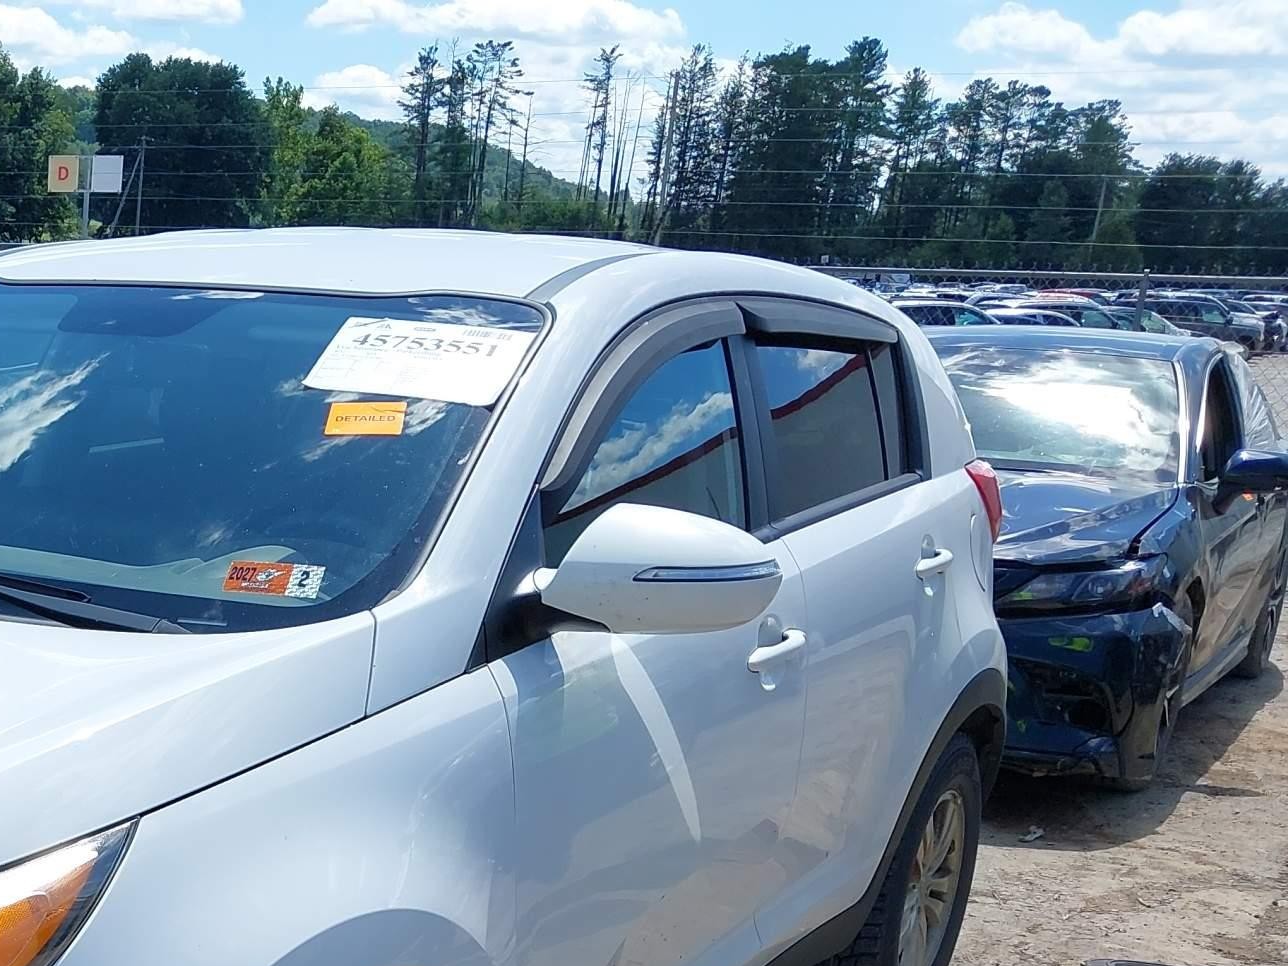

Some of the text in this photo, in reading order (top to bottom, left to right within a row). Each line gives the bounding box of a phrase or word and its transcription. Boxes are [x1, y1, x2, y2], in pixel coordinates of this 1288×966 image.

[58, 166, 69, 181] D
[351, 332, 498, 357] 45753551
[335, 414, 396, 423] DETAILED
[228, 566, 310, 588] 2027 2
